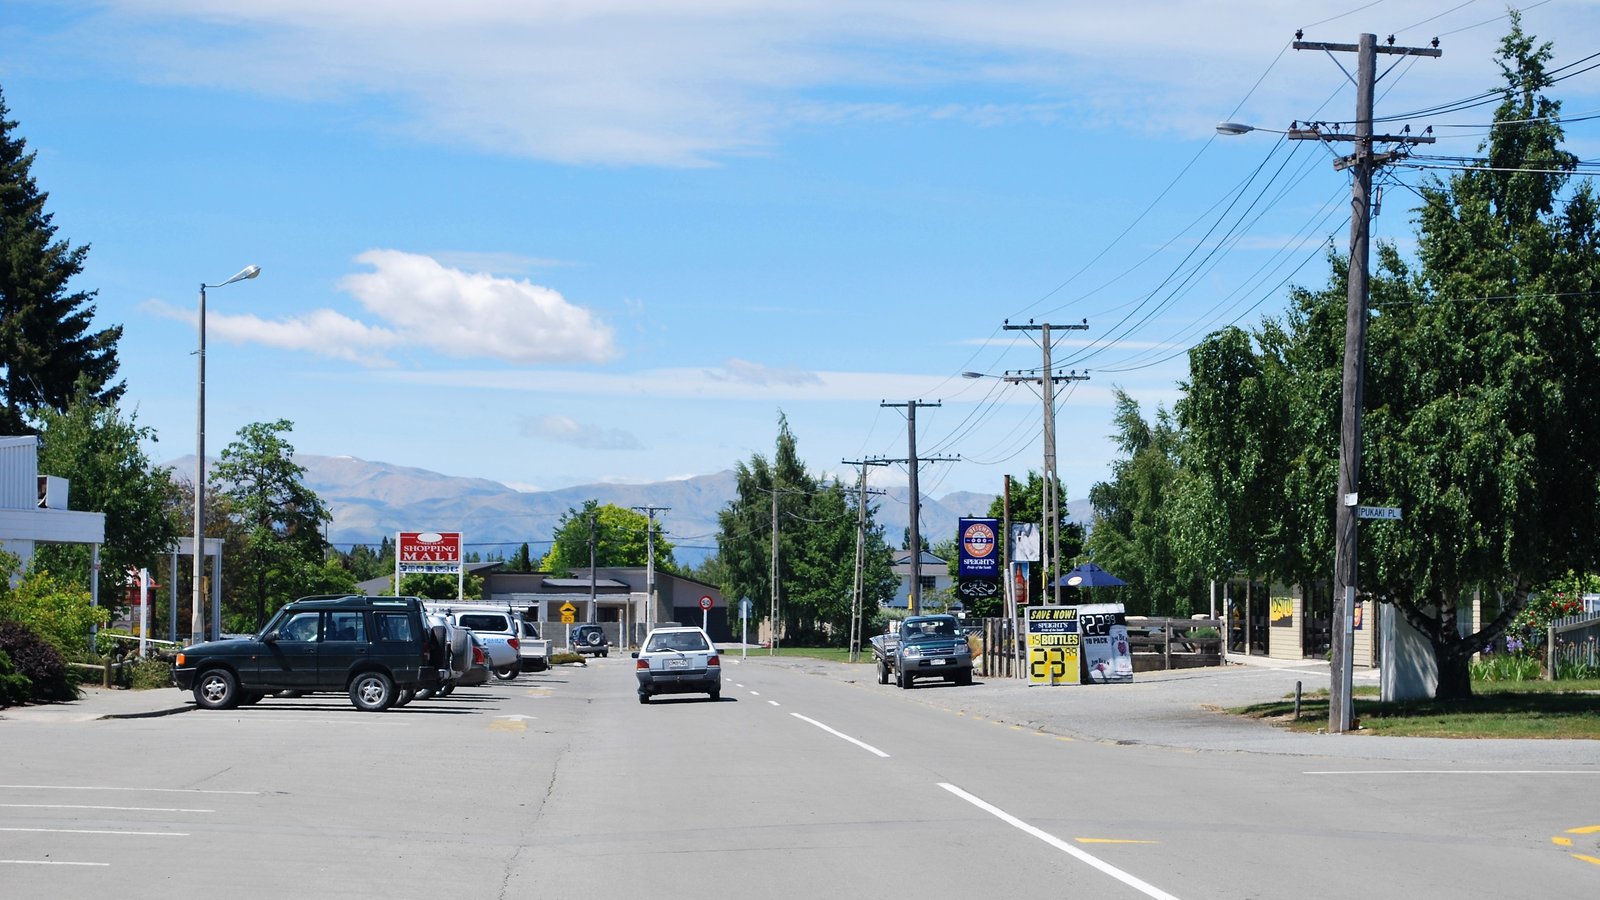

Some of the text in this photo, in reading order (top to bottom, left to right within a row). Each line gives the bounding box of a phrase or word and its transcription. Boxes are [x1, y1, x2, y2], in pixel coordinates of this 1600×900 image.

[1360, 508, 1396, 518] PUKAKI PL
[403, 552, 457, 561] MALL
[1030, 609, 1076, 620] SAVE NOW!
[1041, 635, 1078, 645] BOTTLES
[1093, 637, 1109, 645] PACK
[1031, 648, 1065, 677] 23
